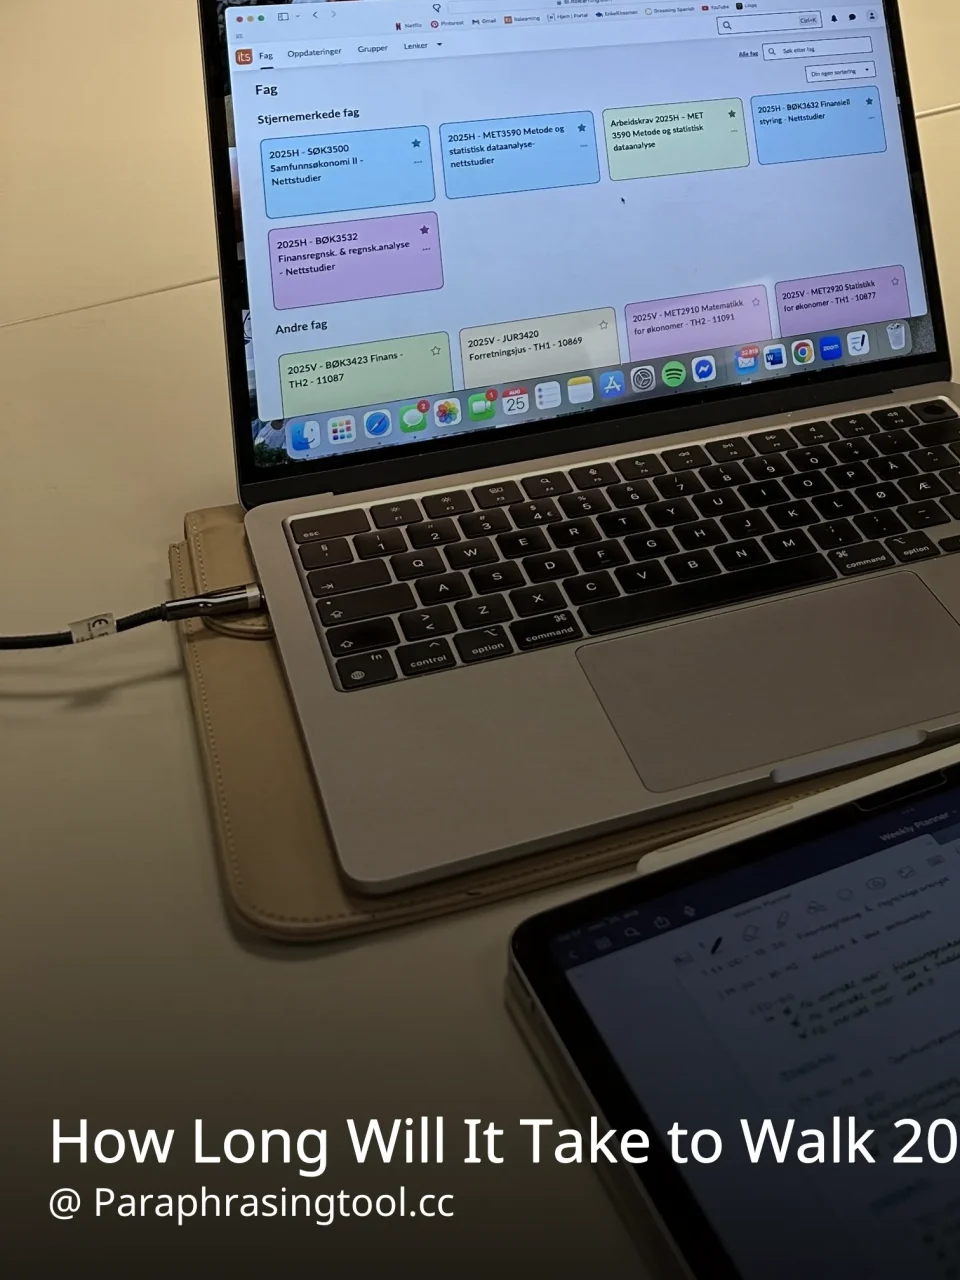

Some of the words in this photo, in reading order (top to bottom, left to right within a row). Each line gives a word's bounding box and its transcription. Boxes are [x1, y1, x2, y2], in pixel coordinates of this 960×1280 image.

[287, 47, 342, 59] Oppdateringer
[358, 44, 388, 54] Grupper
[403, 42, 428, 50] Lenker
[259, 52, 274, 61] Fag
[255, 84, 278, 97] Fag
[758, 104, 781, 113] 2025H
[257, 108, 341, 125] Stjernemerkede
[343, 108, 360, 119] fag
[610, 117, 654, 127] Arbeidskrav
[655, 114, 680, 123] 2025H
[687, 112, 704, 120] MET
[759, 117, 783, 125] styring
[788, 113, 825, 123] Nettstudier
[448, 133, 476, 143] 2025H
[483, 128, 521, 139] MET3590
[523, 126, 553, 135] Metode
[555, 126, 565, 134] og
[612, 131, 631, 139] 3590
[632, 128, 661, 137] Metode
[672, 124, 704, 134] statistisk
[269, 149, 300, 159] 2025H
[307, 144, 349, 156] SØK3500
[449, 145, 485, 155] statistisk
[613, 141, 656, 152] dataanalyse
[270, 158, 350, 173] Samfunnsøkonomi
[450, 157, 495, 168] nettstudier
[271, 174, 322, 186] Nettstudier
[276, 239, 307, 250] 2025H
[315, 233, 358, 245] BØK3532
[278, 249, 338, 263] Finansregnsk.
[348, 240, 410, 255] regnsk.analyse
[285, 263, 336, 276] Nettstudier
[782, 291, 805, 300] 2025V
[811, 285, 844, 296] MET2920
[845, 280, 875, 291] Statistikk
[784, 304, 794, 312] for
[795, 300, 829, 311] økonomer
[835, 296, 849, 304] TH1
[855, 292, 876, 301] 10877
[633, 312, 658, 322] 2025V
[664, 306, 700, 318] MET2910
[701, 300, 744, 312] Matematikk
[275, 321, 308, 335] Andre
[311, 320, 328, 331] fag
[634, 327, 645, 335] for
[646, 322, 683, 334] økonomer
[690, 318, 706, 327] TH2
[712, 313, 735, 323] 11091
[467, 337, 495, 348] 2025V
[502, 330, 539, 343] JUR3420
[469, 345, 527, 361] Forretningsjus
[533, 341, 551, 352] TH1
[558, 336, 583, 348] 10869
[287, 364, 317, 375] 2025V
[325, 356, 368, 370] BØK3423
[370, 352, 398, 363] Finans
[289, 379, 308, 389] TH2
[316, 374, 344, 384] 11087
[506, 397, 525, 411] 25
[903, 545, 930, 556] option
[845, 554, 887, 570] command
[525, 627, 574, 642] command
[471, 642, 504, 655] option
[371, 652, 383, 661] fn
[410, 654, 447, 668] control
